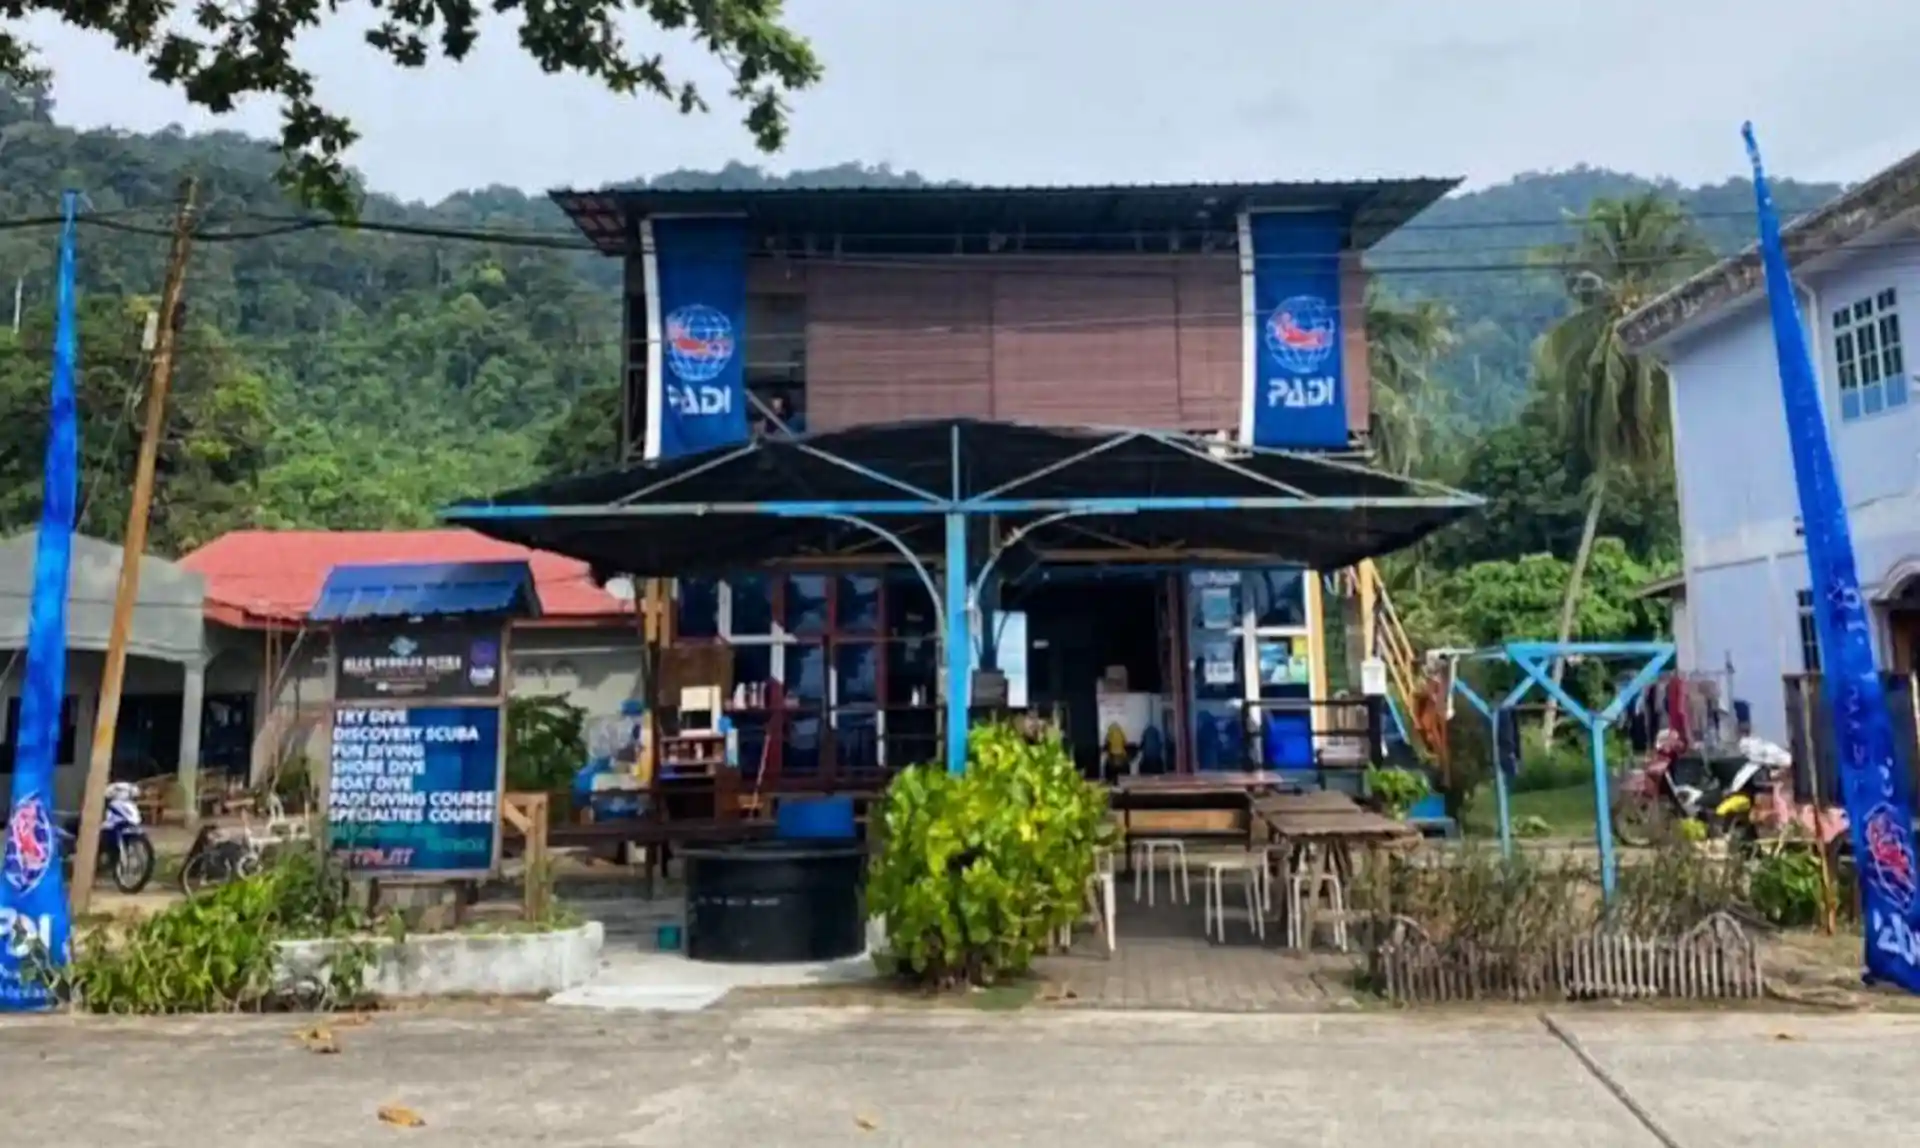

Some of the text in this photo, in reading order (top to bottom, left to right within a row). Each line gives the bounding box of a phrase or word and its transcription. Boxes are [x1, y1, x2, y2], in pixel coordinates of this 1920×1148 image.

[1267, 376, 1335, 408] PADI
[336, 709, 408, 724] TRY DIVE
[332, 725, 480, 742] DISCOVERY SCUBA
[331, 743, 425, 759] FUN DIVING
[331, 760, 426, 775] SHORE DIVE
[330, 776, 413, 791] BOAT DIVE
[369, 791, 426, 806] DIVING
[429, 791, 494, 807] COURSE
[328, 807, 493, 823] SPECIALTIES COURSE
